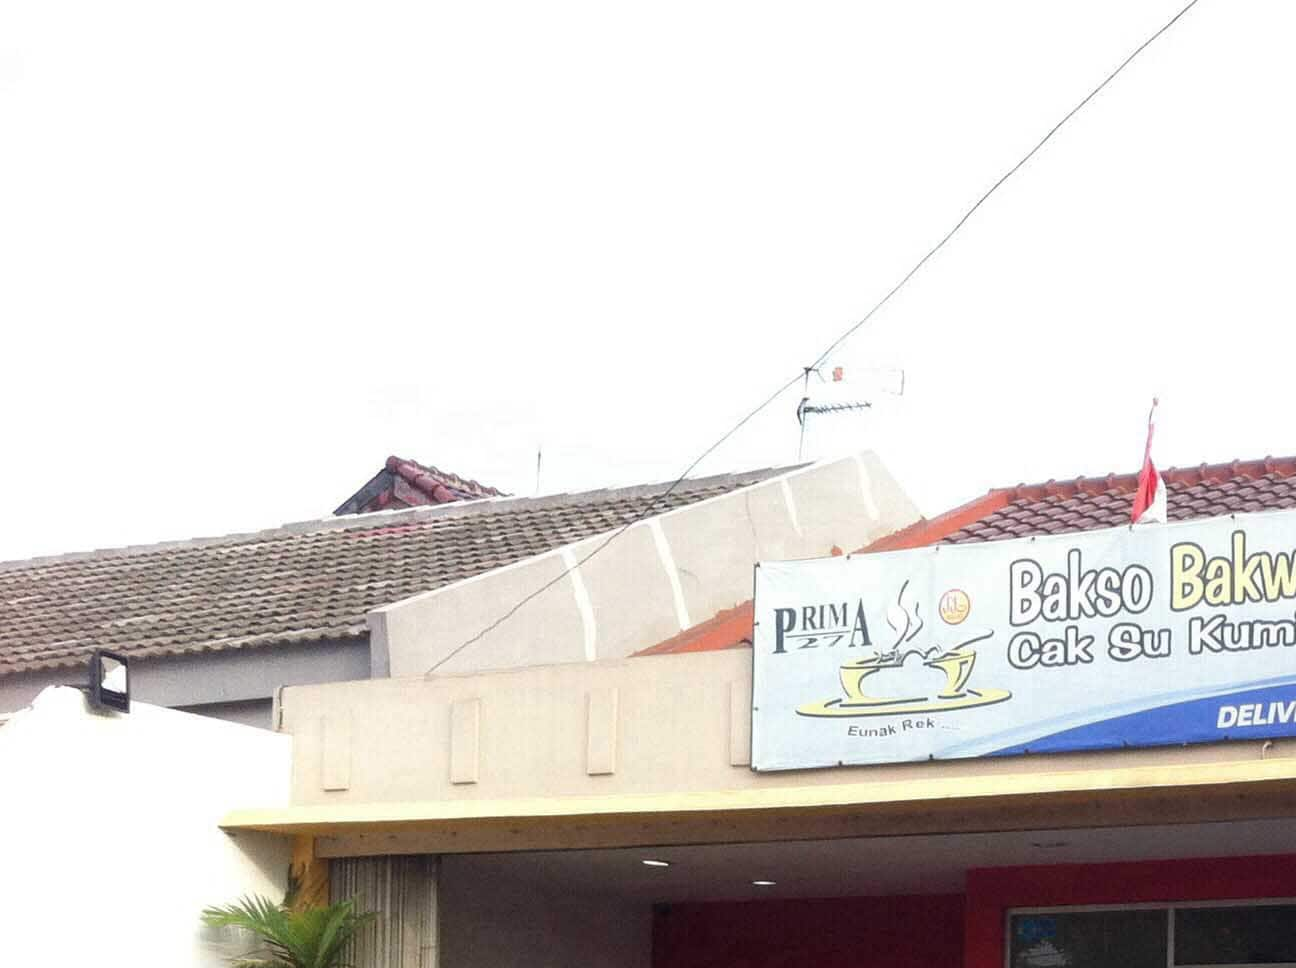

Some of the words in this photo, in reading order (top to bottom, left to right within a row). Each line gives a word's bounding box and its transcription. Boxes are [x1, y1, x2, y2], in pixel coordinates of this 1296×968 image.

[1009, 548, 1154, 626] Bakso
[773, 597, 873, 654] PRIMA
[797, 634, 846, 650] 27
[1007, 625, 1093, 671] Cak
[1107, 622, 1173, 660] Su
